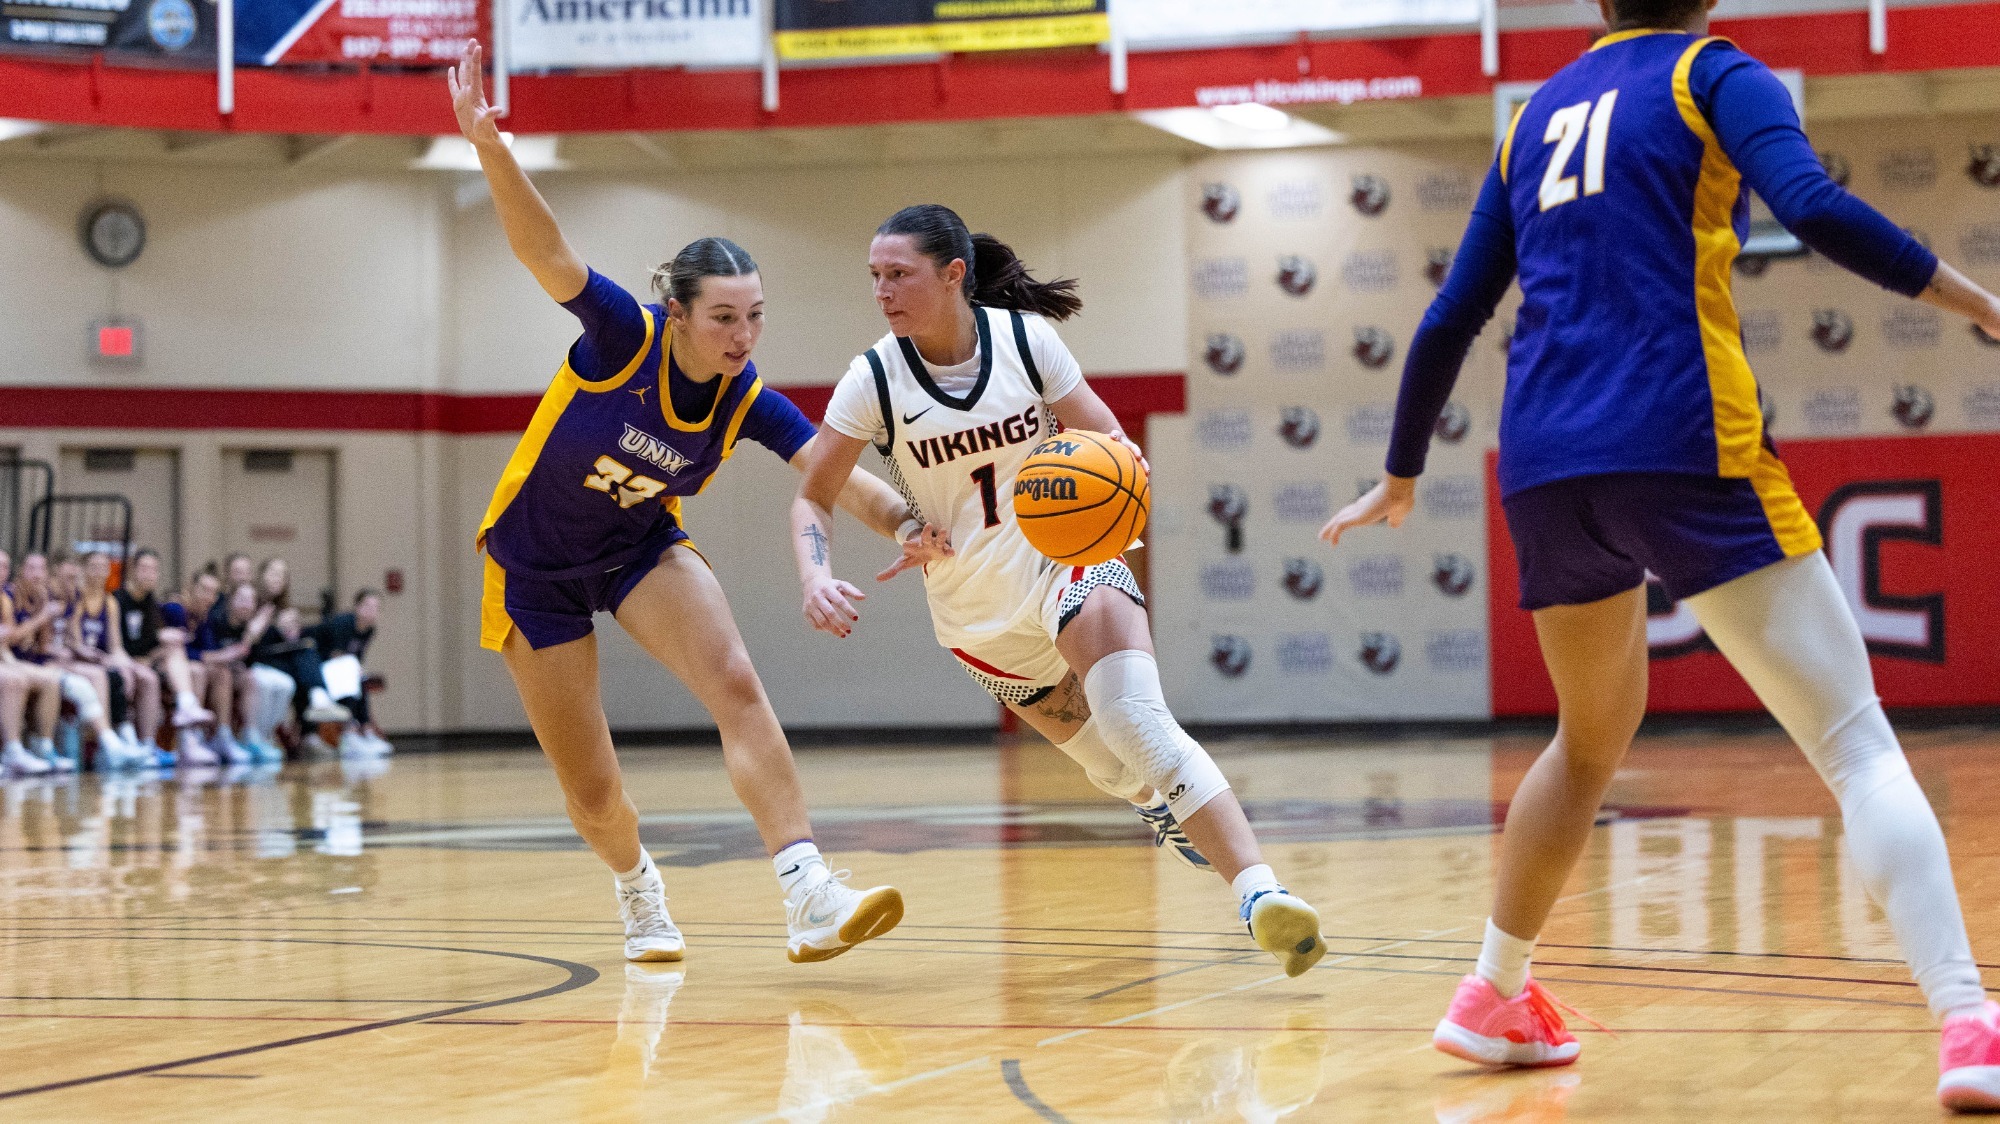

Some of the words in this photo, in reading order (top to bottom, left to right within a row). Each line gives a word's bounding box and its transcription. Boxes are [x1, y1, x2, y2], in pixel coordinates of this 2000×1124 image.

[1538, 88, 1619, 212] 21
[618, 422, 694, 476] UNW
[906, 404, 1040, 469] VIKINGS
[970, 461, 1002, 529] 1
